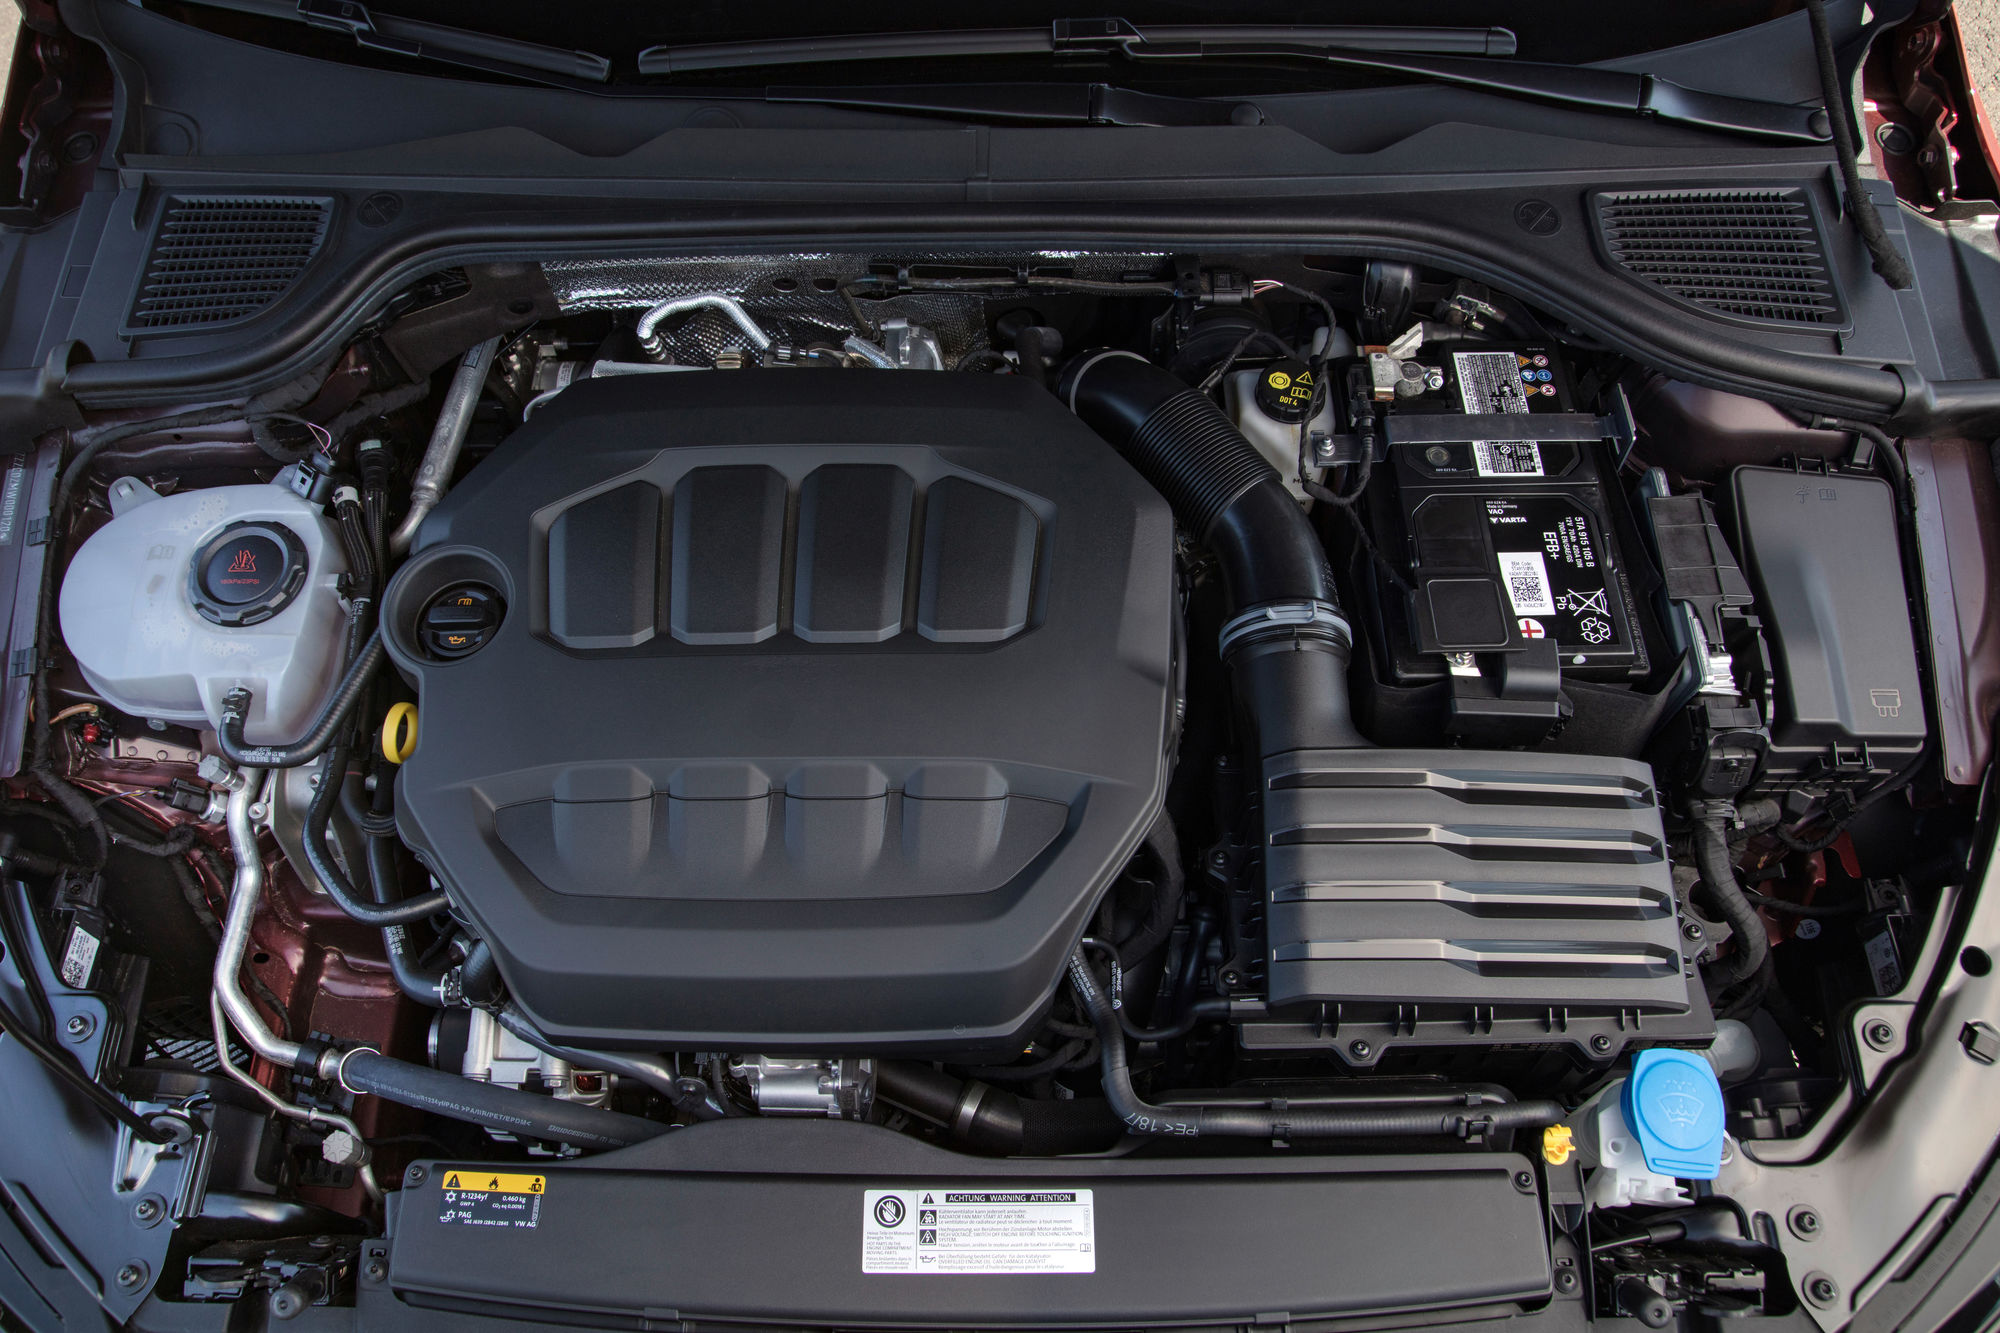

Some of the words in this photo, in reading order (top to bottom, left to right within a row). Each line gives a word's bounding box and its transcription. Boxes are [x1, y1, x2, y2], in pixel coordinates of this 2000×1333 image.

[1279, 396, 1292, 404] DOT
[1565, 516, 1573, 527] 12V
[1574, 516, 1585, 530] 5TA
[1558, 522, 1567, 535] 700A
[1568, 528, 1576, 542] 70Ah
[1578, 531, 1589, 545] 915
[1543, 532, 1560, 560] EFB+
[1572, 544, 1581, 558] 420A
[1582, 547, 1593, 560] 105
[1575, 558, 1583, 568] DIN
[1556, 596, 1567, 610] Pb
[460, 1193, 488, 1201] R-1234yf
